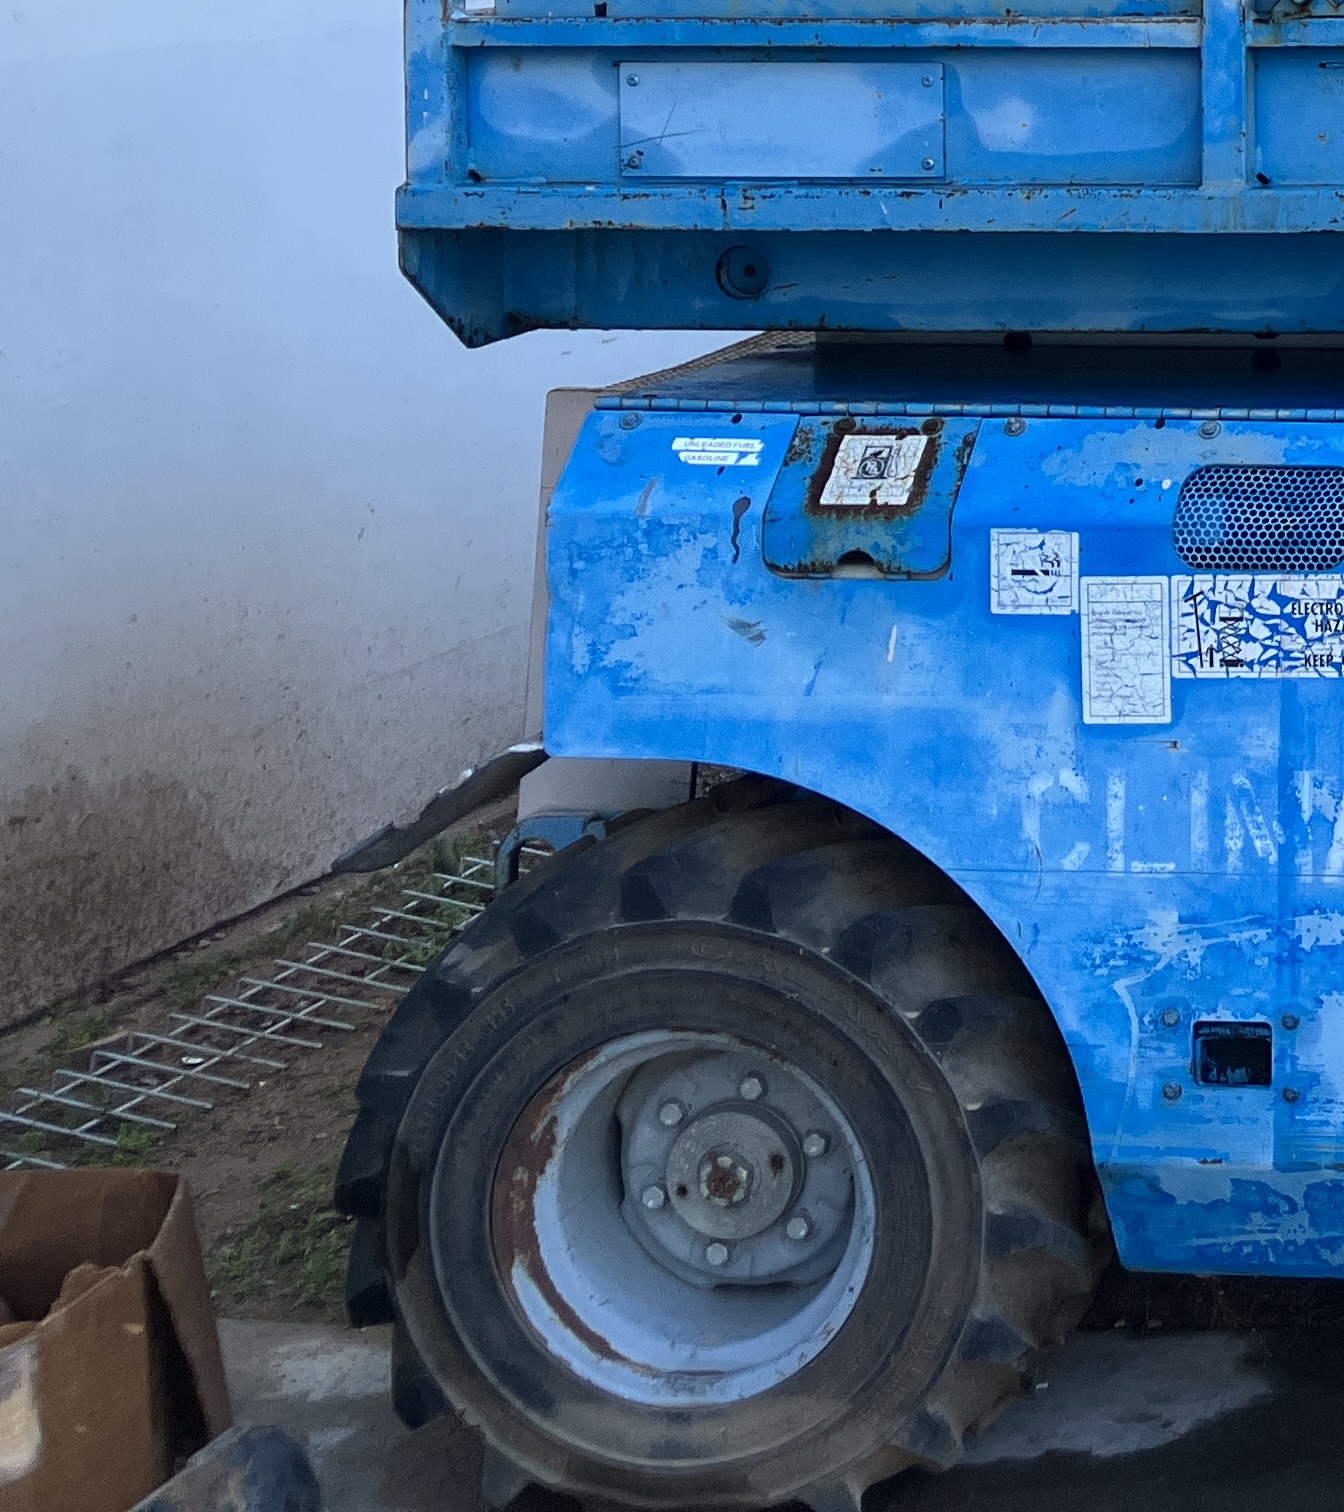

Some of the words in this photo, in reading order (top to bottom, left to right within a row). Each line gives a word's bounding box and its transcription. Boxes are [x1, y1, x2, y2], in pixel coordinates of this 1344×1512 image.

[733, 441, 756, 449] FUEL
[683, 454, 729, 462] GASOLINE
[1304, 653, 1334, 668] KEEP
